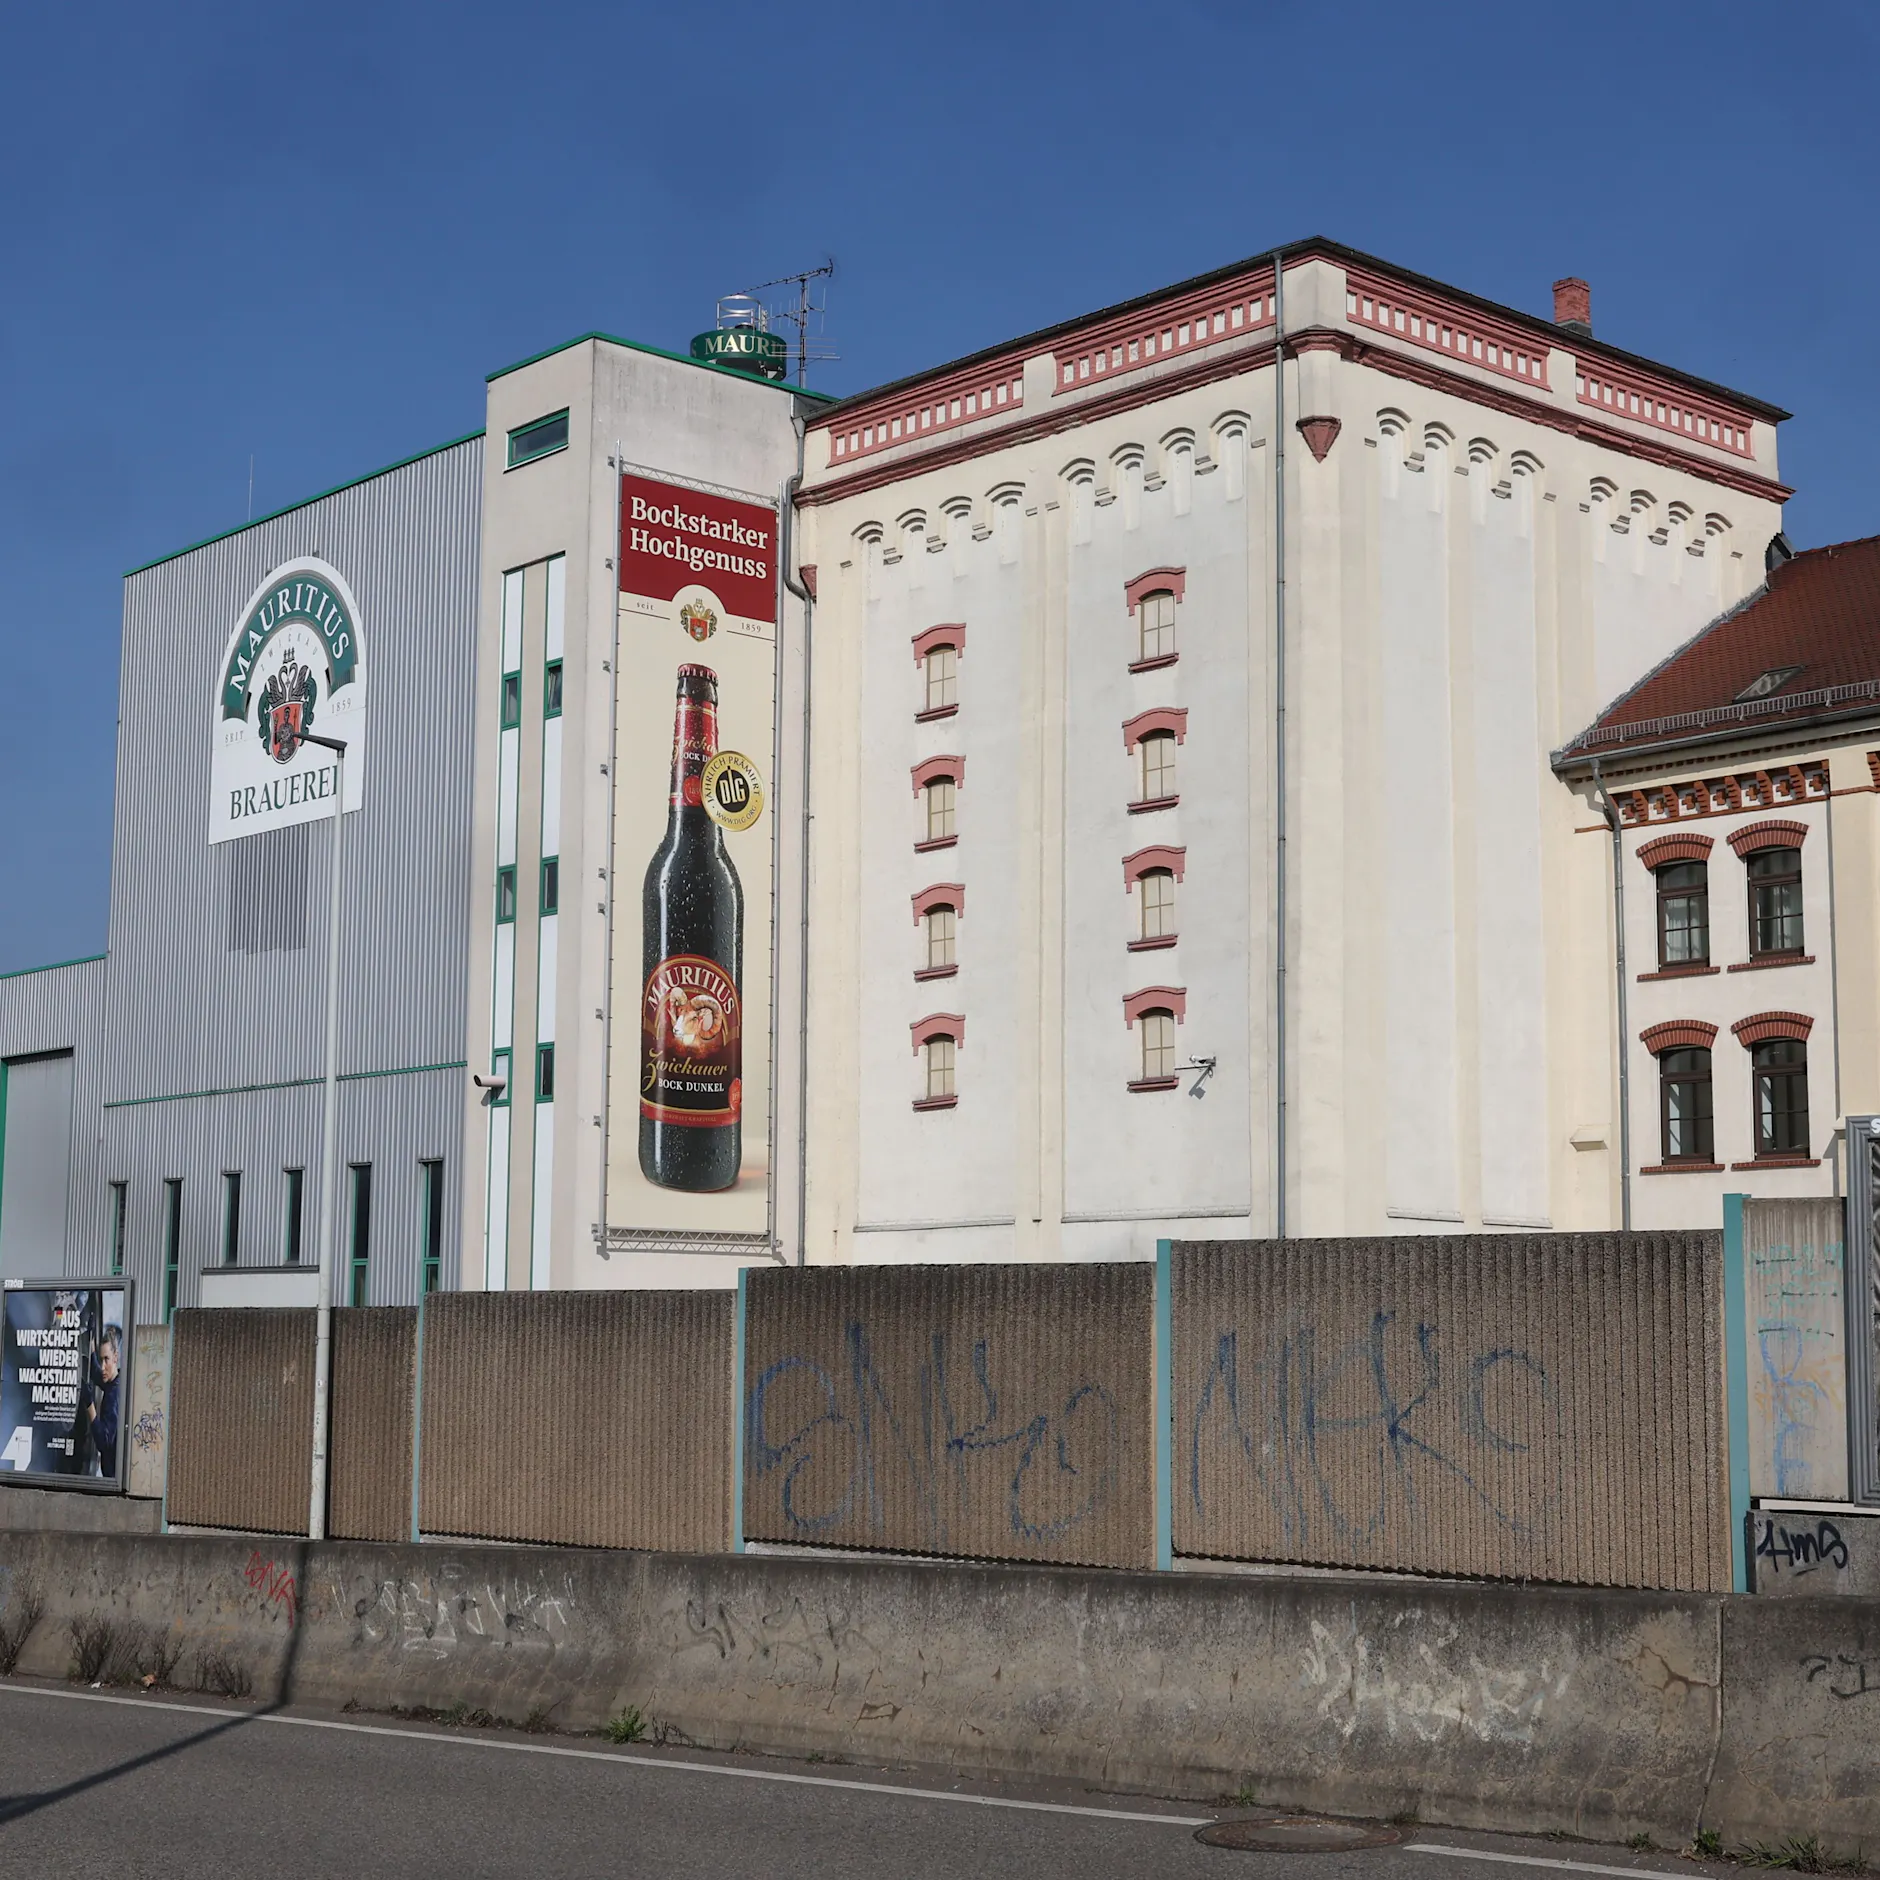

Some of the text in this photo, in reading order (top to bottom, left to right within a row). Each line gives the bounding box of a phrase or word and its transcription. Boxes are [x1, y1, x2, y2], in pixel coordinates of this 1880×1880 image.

[630, 496, 768, 549] Bockstarker
[629, 527, 767, 579] Hochgenuss
[741, 622, 762, 633] 1859
[230, 583, 350, 695] MAURITIUS
[331, 697, 352, 714] 1859
[719, 766, 746, 805] DLG
[728, 756, 760, 796] PRÄMIERT
[647, 965, 735, 1015] MAURITIUS
[642, 1048, 728, 1092] Zwickauer
[658, 1077, 724, 1093] BOCK DUNKEL
[4, 1279, 24, 1289] STRÖER
[60, 1310, 81, 1328] AUS
[16, 1329, 80, 1348] WIRTSCHAFT
[39, 1349, 79, 1367] WIEDER
[18, 1367, 78, 1385] WACHSTUM
[31, 1385, 77, 1404] MACHEN
